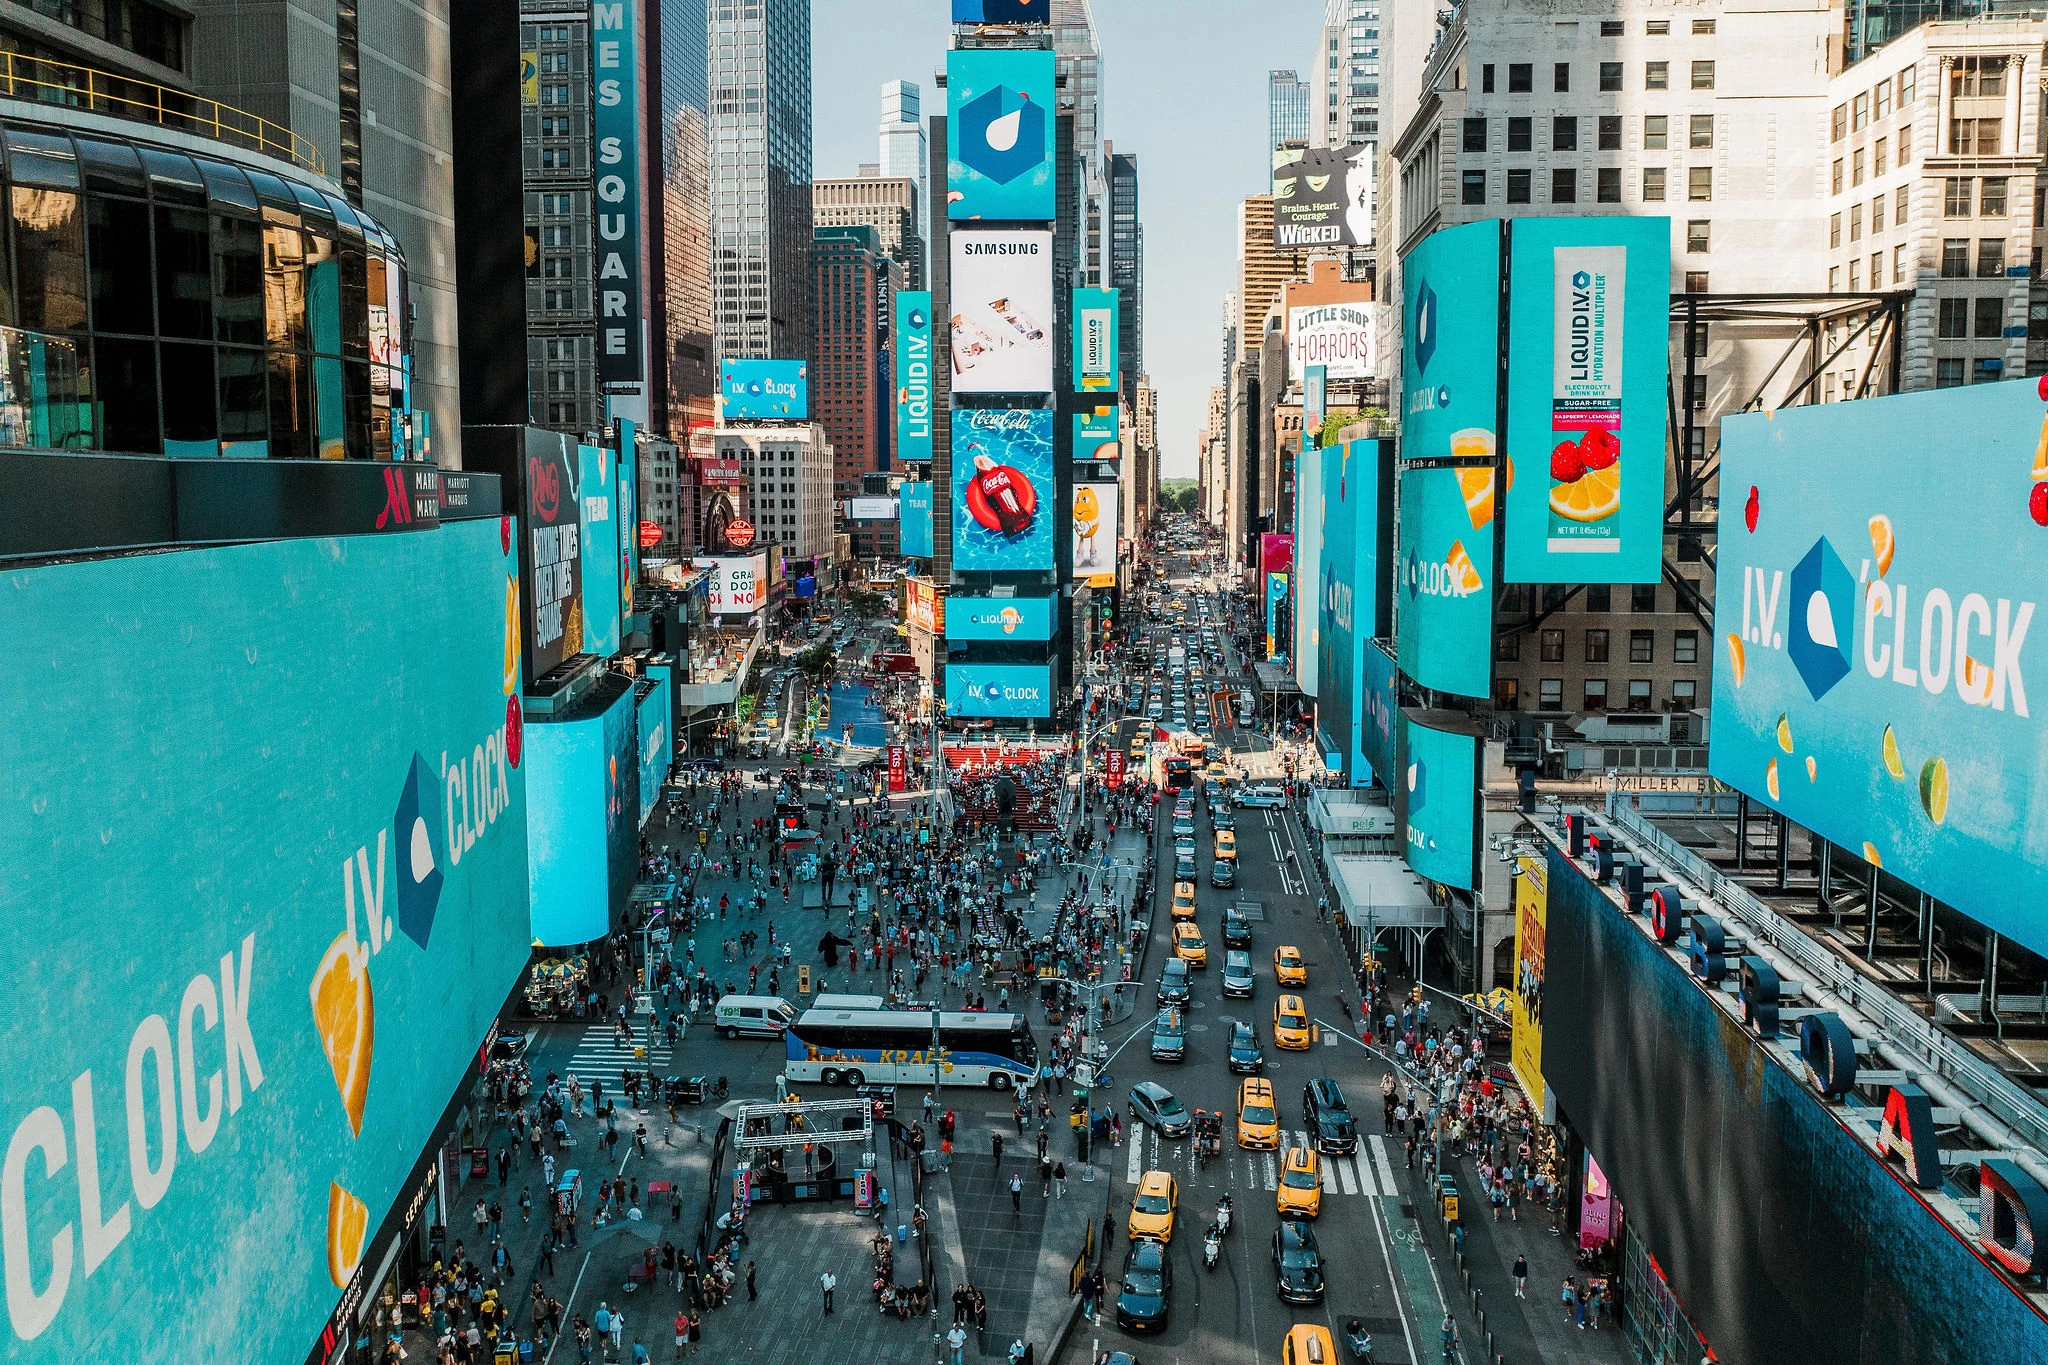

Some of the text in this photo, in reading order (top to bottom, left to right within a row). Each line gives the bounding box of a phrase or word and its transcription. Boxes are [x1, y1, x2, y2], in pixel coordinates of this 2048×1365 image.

[1281, 202, 1340, 213] Brains. Heart.
[1291, 212, 1329, 222] Courage.
[598, 137, 628, 354] SQUARE
[964, 243, 1039, 255] SAMSUNG
[1298, 308, 1370, 332] LITTLE SHOP
[1572, 290, 1590, 381] LIQUID I.V.
[1088, 337, 1097, 366] LIQUID
[1297, 332, 1368, 368] HORRORS
[1593, 330, 1605, 381] HYDRATION
[731, 383, 746, 394] I.V.
[908, 334, 929, 437] LIQUID I.V.
[446, 477, 470, 489] MARRIOTT
[447, 494, 468, 506] MARQUIS
[585, 496, 609, 522] TEAR
[908, 499, 927, 508] TEAR
[1558, 526, 1568, 535] NET
[980, 614, 1014, 624] LIQUID
[1742, 566, 1784, 651] I.V.
[968, 685, 983, 698] I.V.
[892, 748, 901, 768] tkts
[1110, 752, 1121, 773] tkts
[1616, 777, 1682, 791] MILLER
[343, 827, 393, 968] I.V.
[1, 932, 265, 1342] CLOCK
[405, 1162, 438, 1231] SEPHORA
[1584, 1208, 1607, 1220] BLIND
[1585, 1215, 1606, 1227] BOX
[335, 1264, 364, 1321] MARRIOTT
[337, 1286, 362, 1336] MARQUIS
